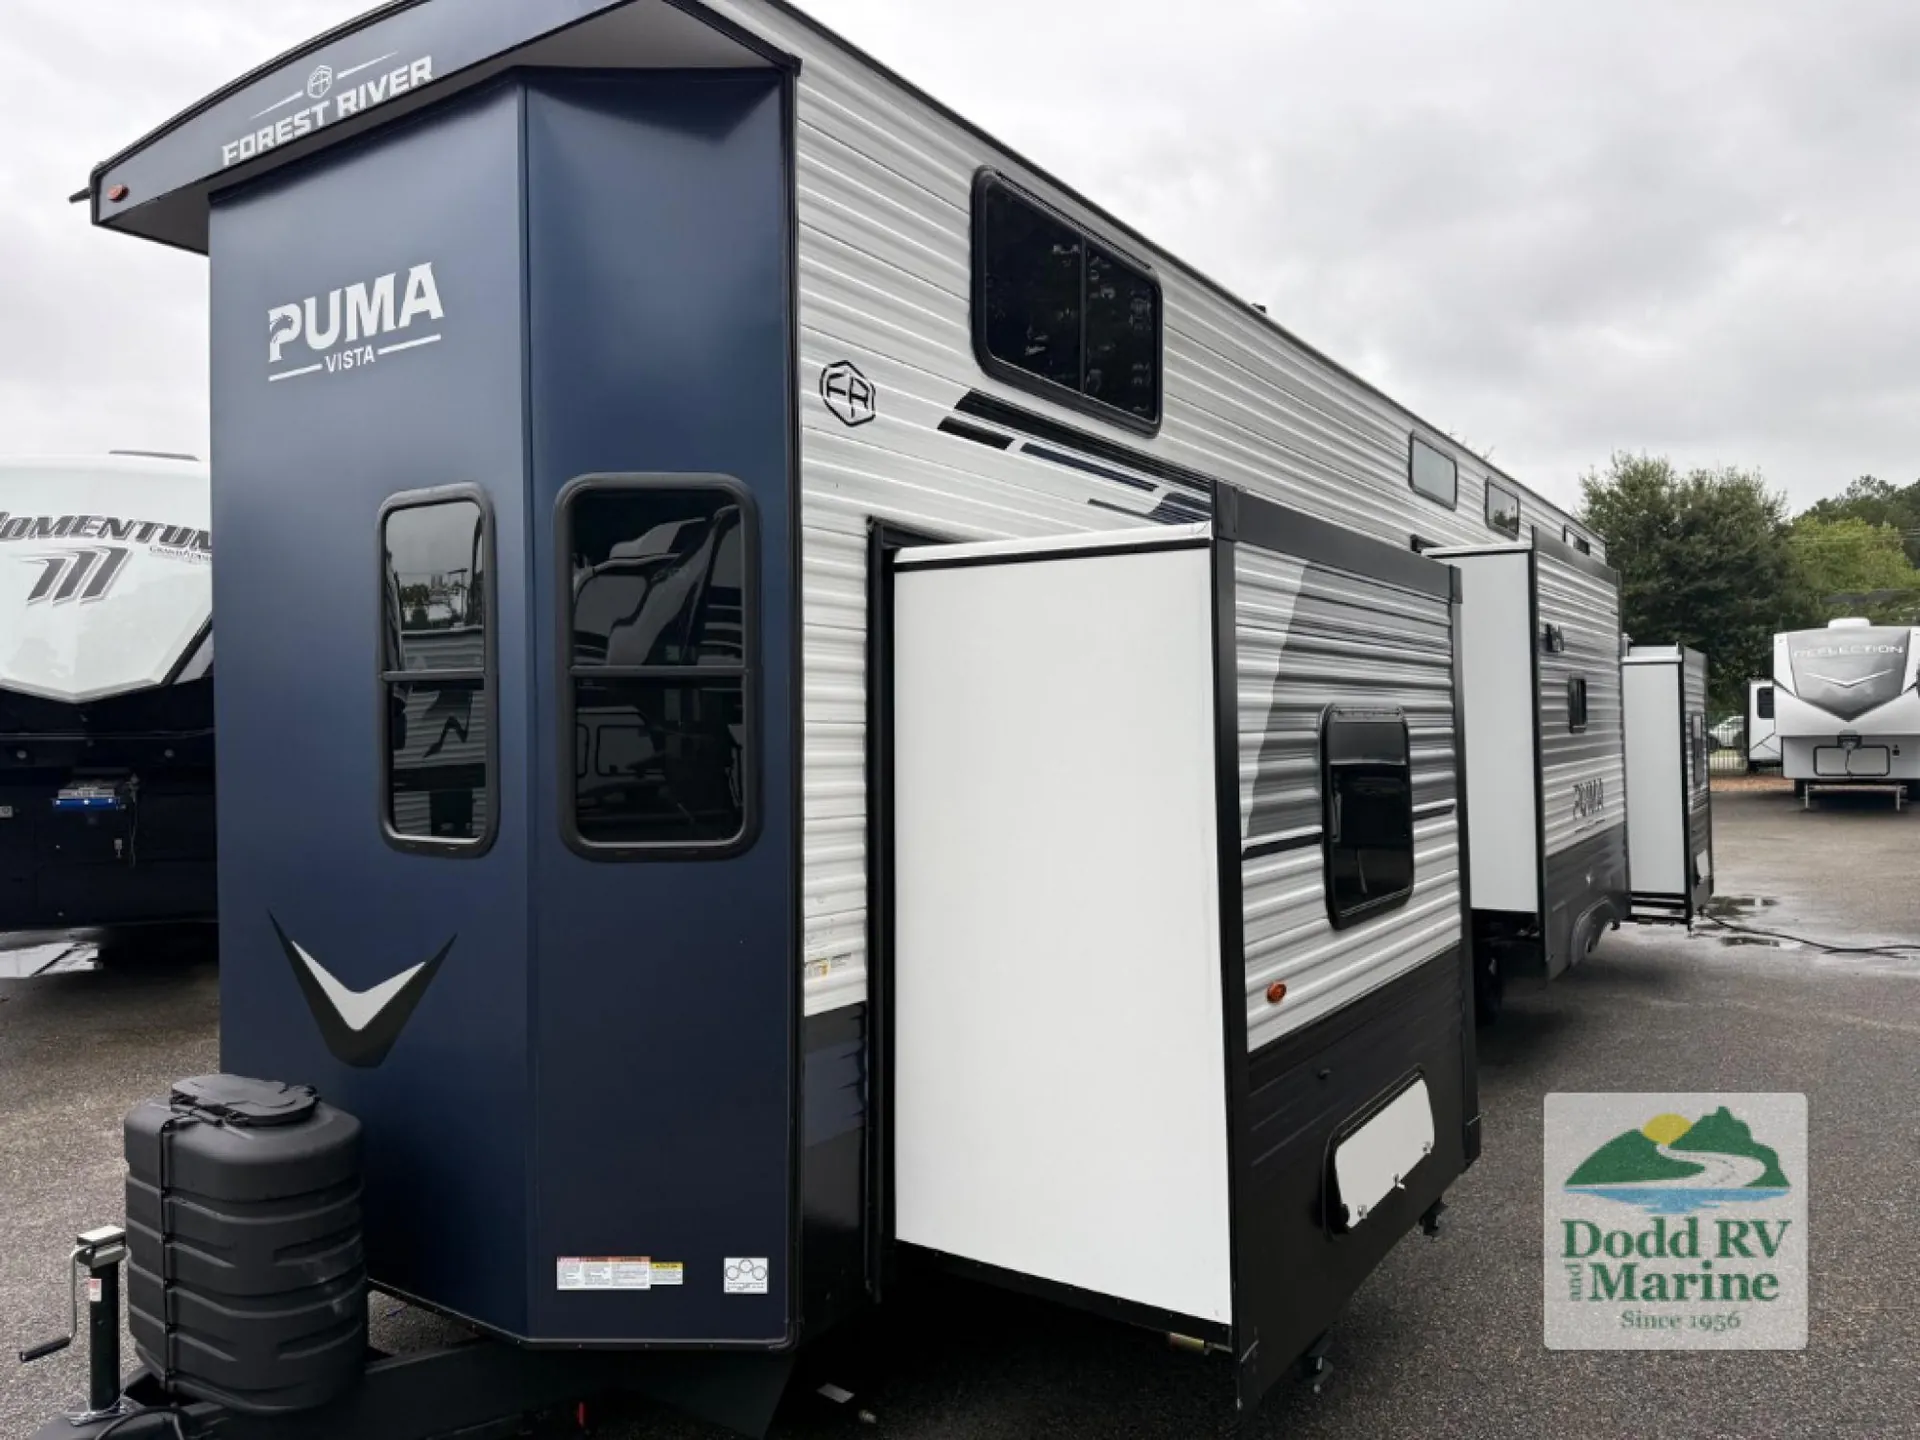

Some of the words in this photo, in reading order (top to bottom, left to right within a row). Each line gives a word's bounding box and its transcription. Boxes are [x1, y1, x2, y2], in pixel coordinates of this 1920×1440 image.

[221, 100, 331, 166] FOREST
[336, 55, 433, 118] RIVER
[268, 261, 445, 363] PUMA
[324, 344, 376, 373] VISTA
